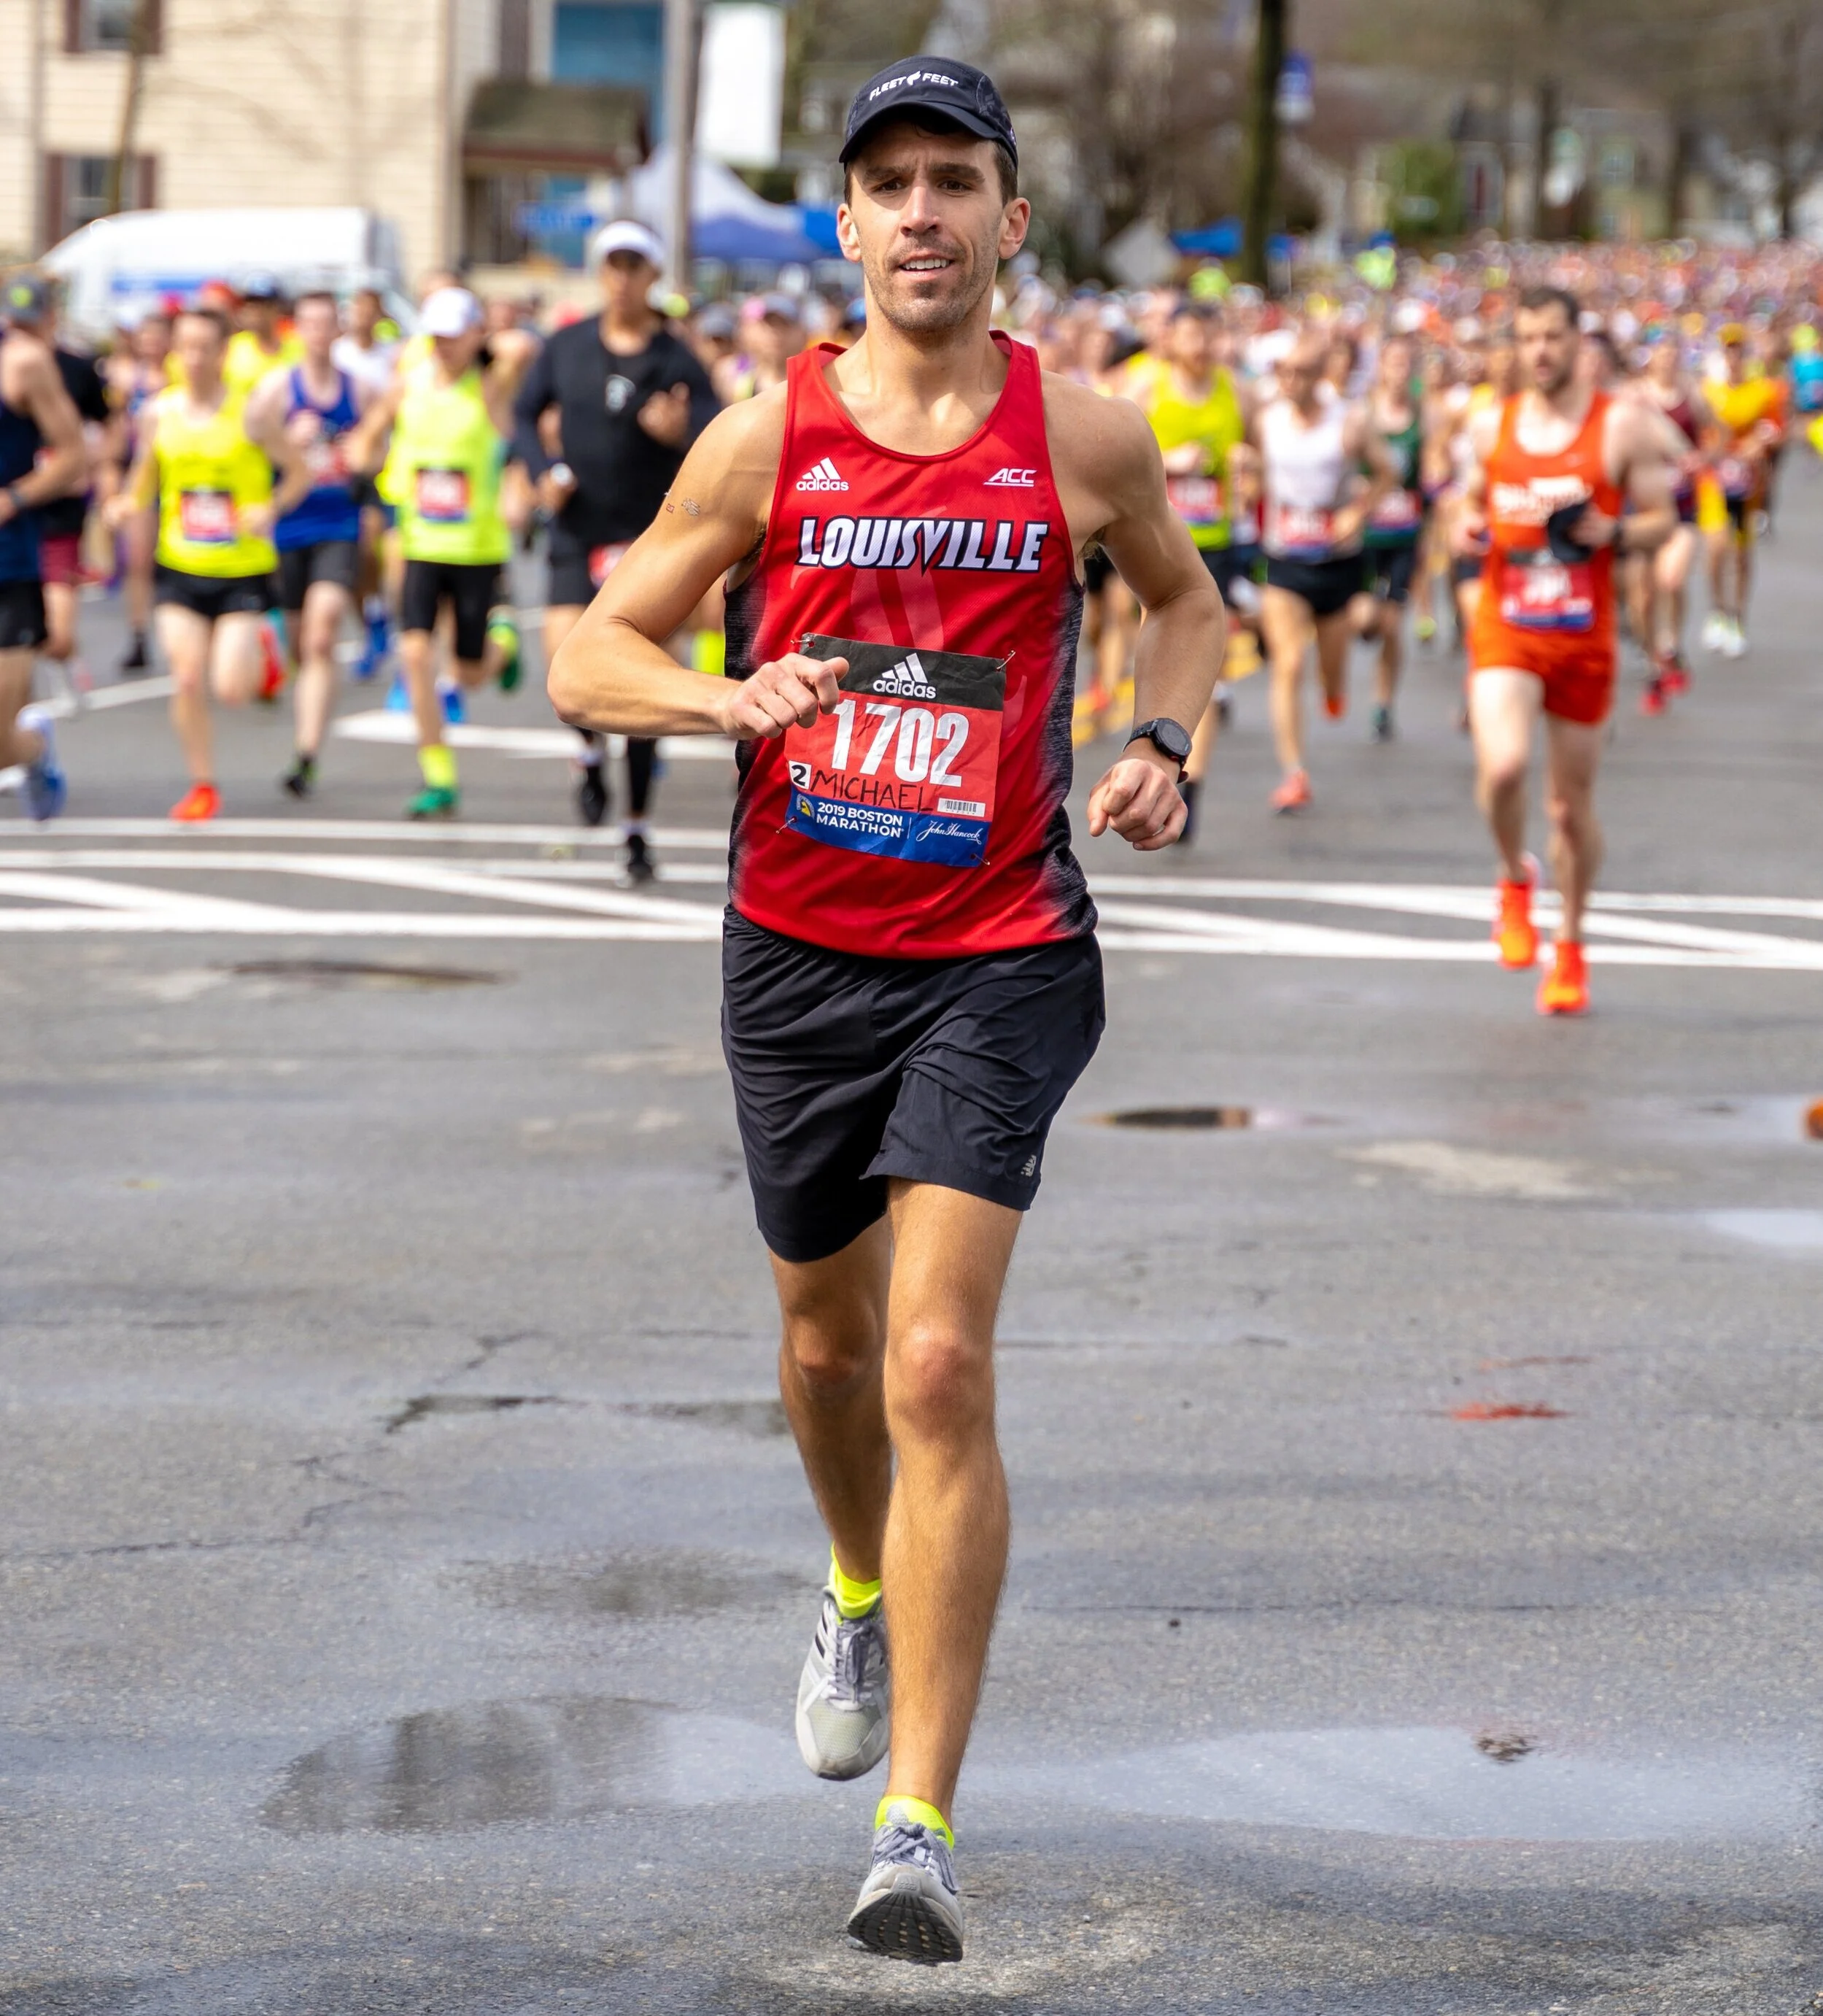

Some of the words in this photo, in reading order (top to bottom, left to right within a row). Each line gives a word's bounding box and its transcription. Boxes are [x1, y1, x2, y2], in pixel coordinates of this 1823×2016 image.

[870, 77, 907, 101] FLEET
[922, 73, 959, 86] FEET
[796, 478, 849, 491] adidas
[984, 468, 1037, 487] ACC
[795, 515, 1050, 576] LOUISVILLE
[872, 678, 937, 699] adidas
[832, 698, 969, 787] 1702
[791, 764, 807, 787] 2
[810, 770, 933, 813] MICHAEL
[816, 814, 902, 838] MARATHON
[817, 802, 845, 816] 2019
[847, 807, 903, 826] BOSTON
[916, 820, 945, 842] John
